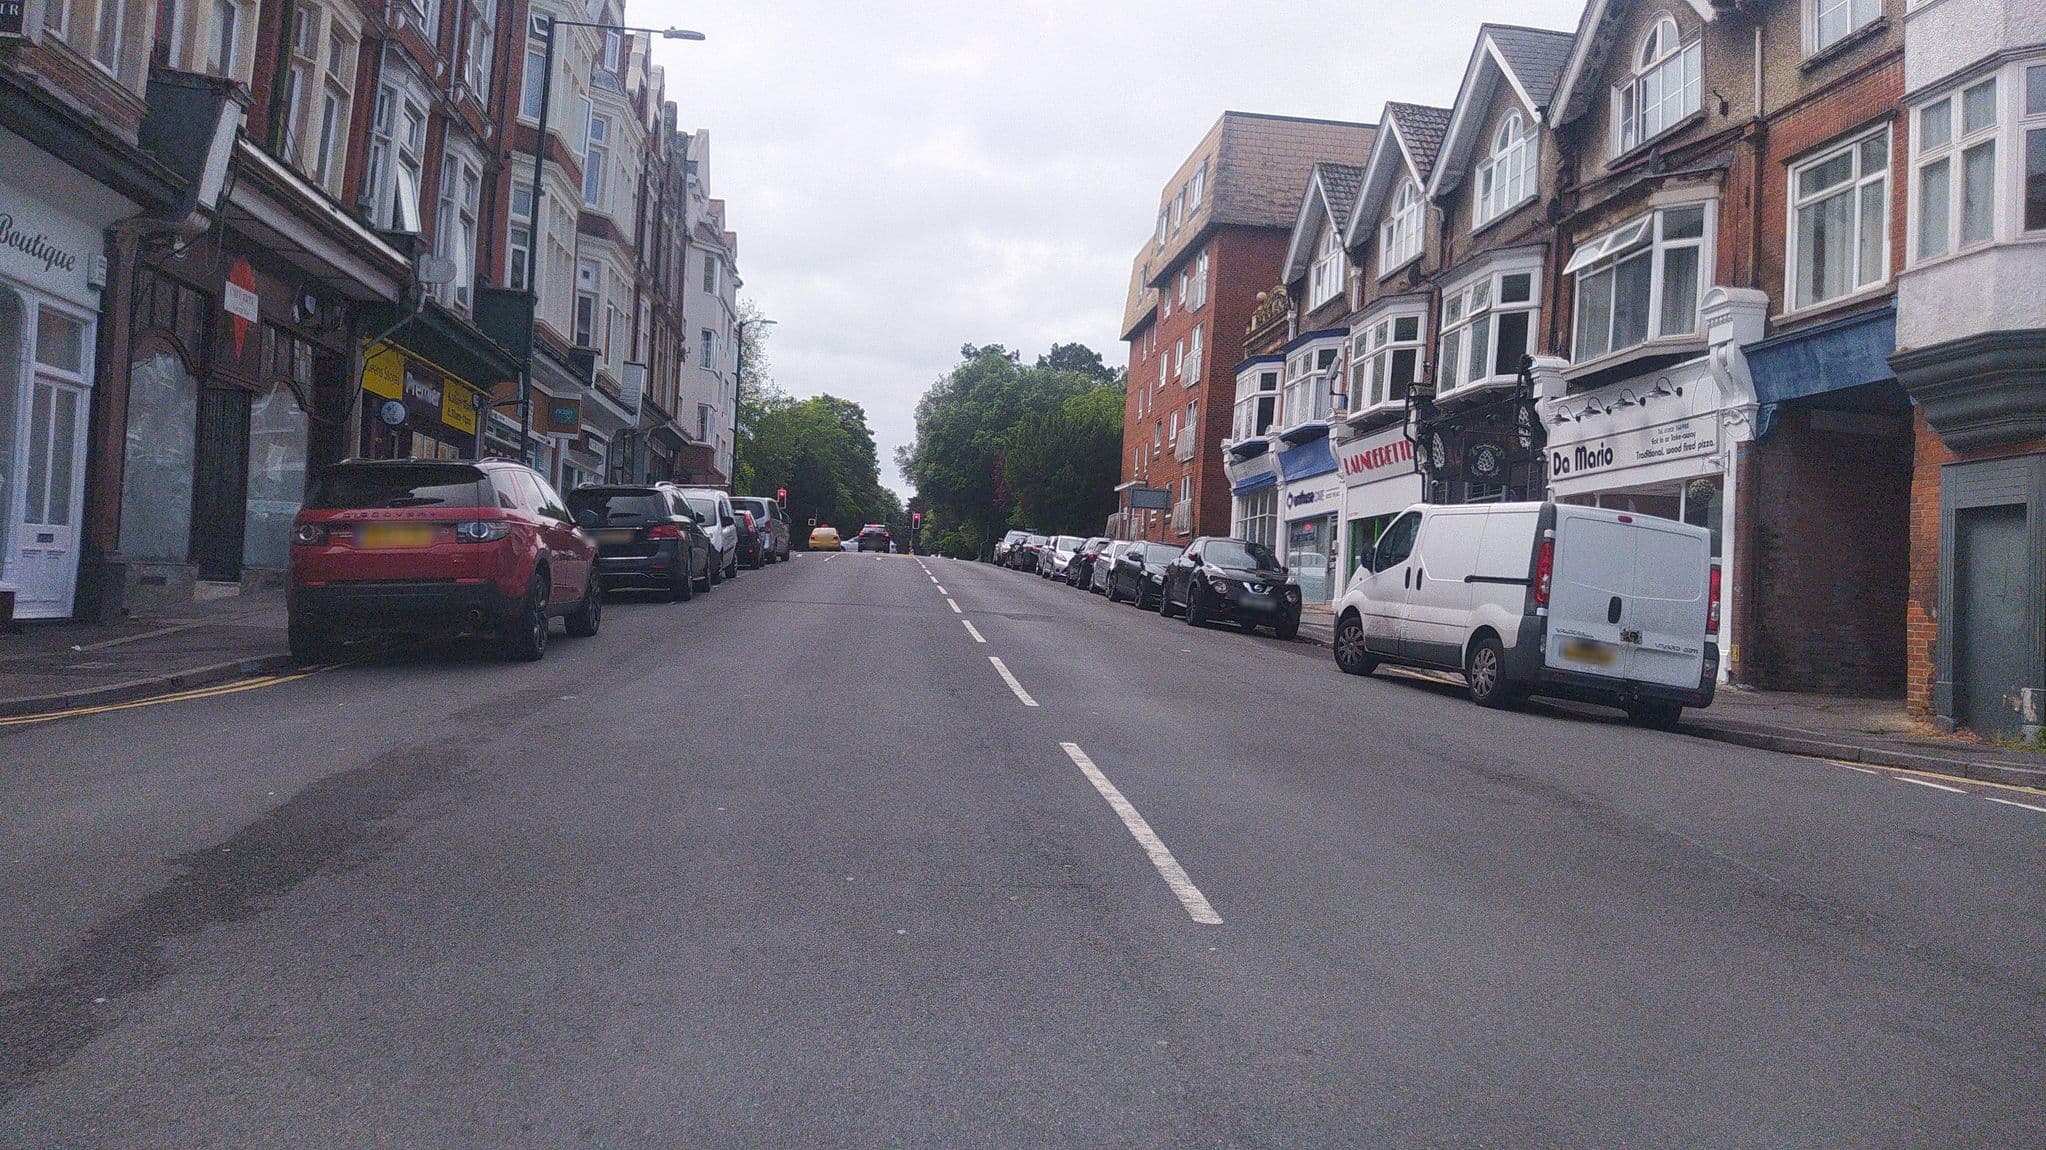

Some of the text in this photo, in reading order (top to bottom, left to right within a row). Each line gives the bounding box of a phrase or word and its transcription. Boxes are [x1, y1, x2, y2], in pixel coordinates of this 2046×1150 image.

[0, 213, 76, 273] Boutique
[1343, 439, 1413, 476] LAUNDERETTE
[1553, 441, 1614, 476] Da Mario
[1666, 443, 1682, 454] wood
[1683, 440, 1697, 451] fired
